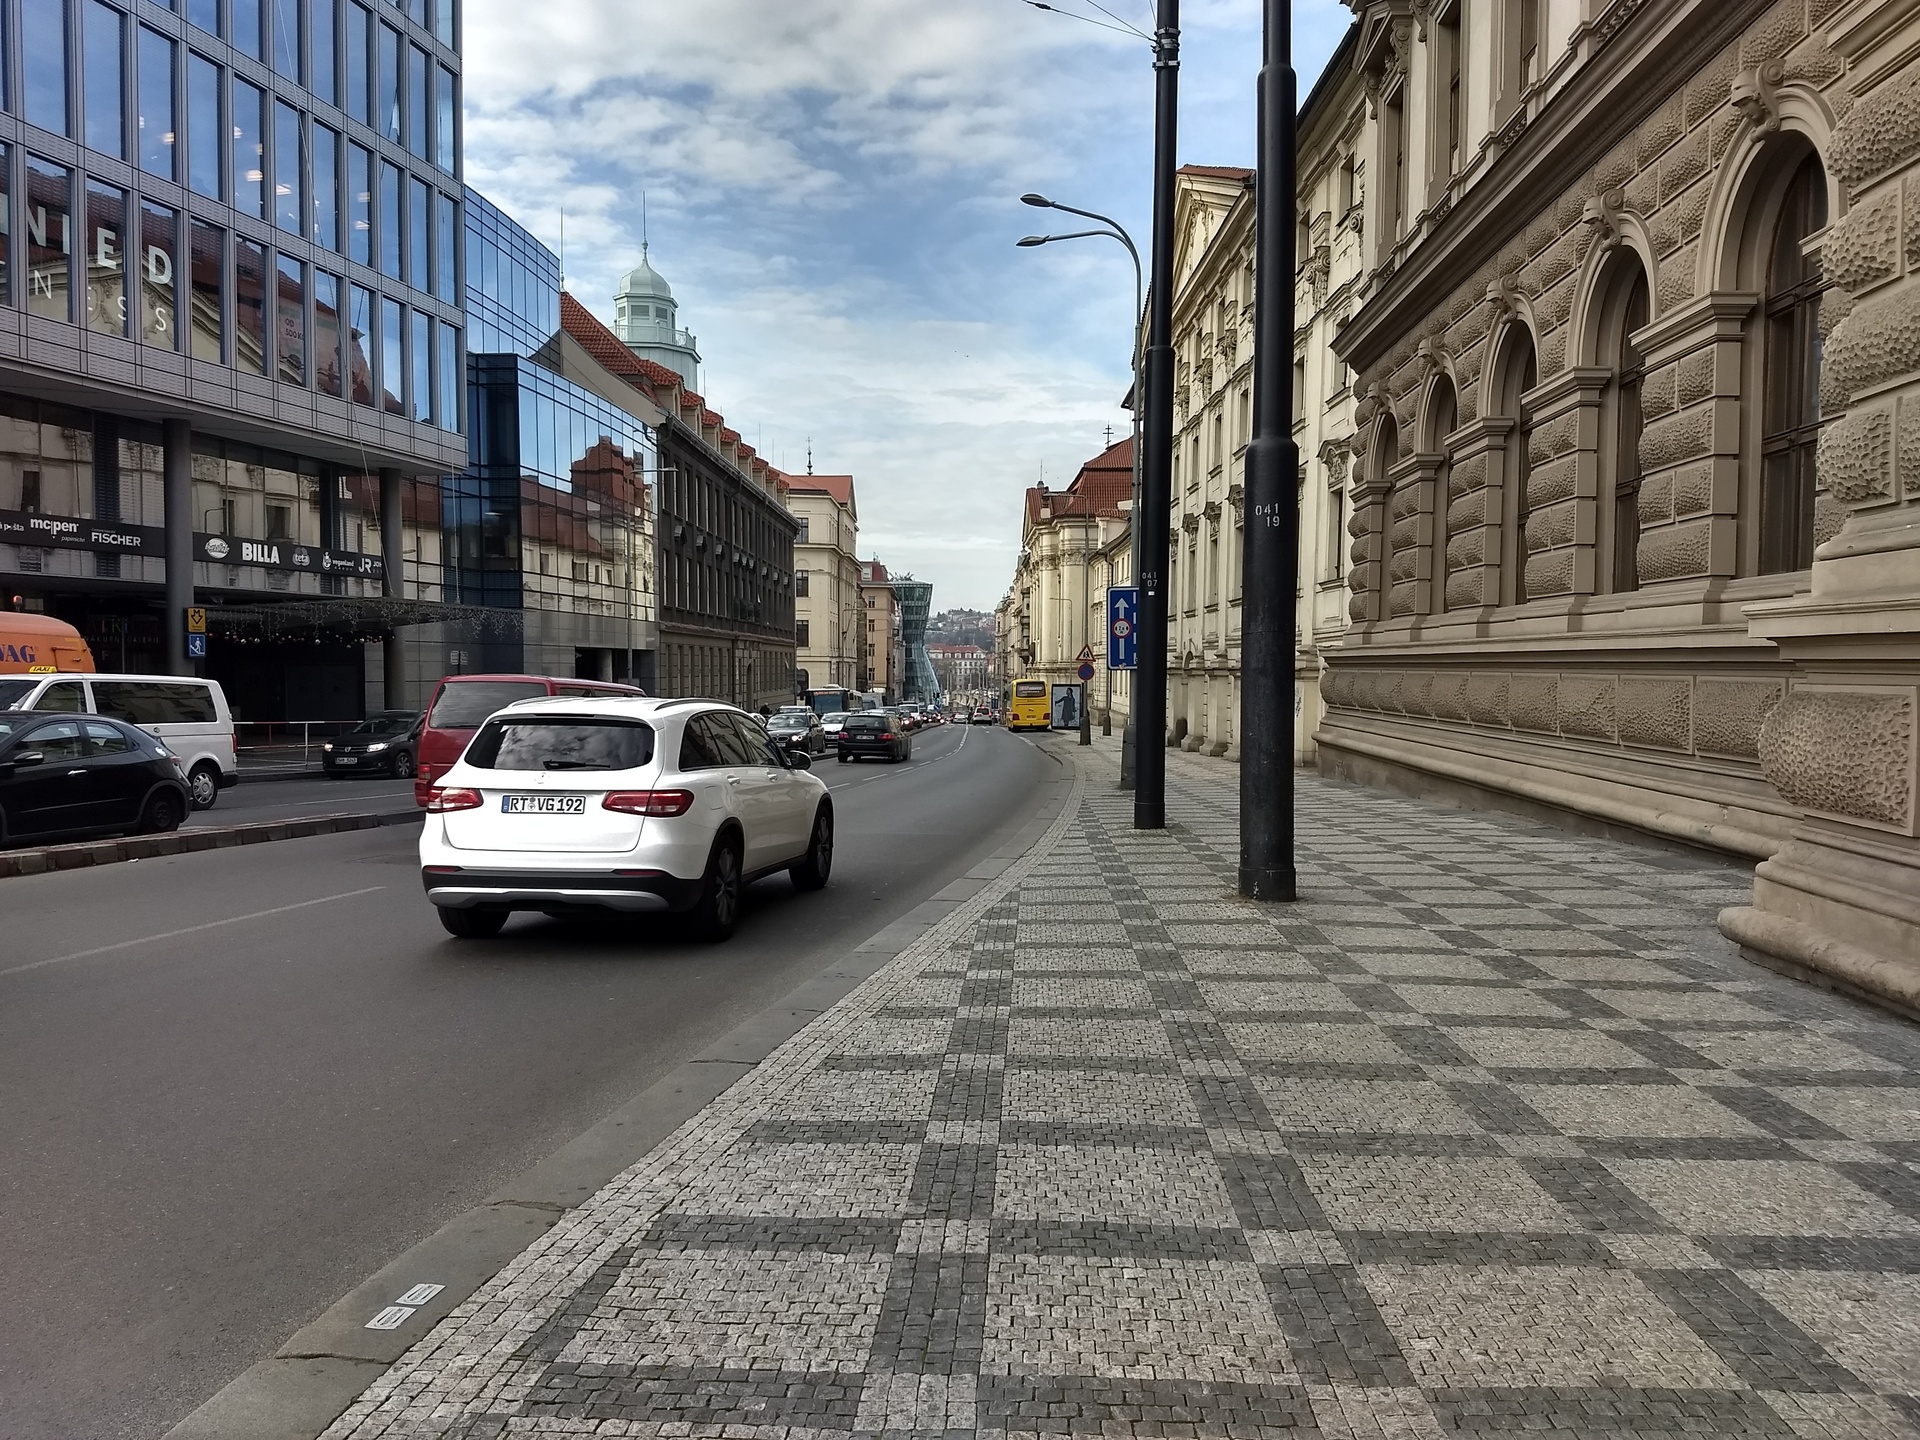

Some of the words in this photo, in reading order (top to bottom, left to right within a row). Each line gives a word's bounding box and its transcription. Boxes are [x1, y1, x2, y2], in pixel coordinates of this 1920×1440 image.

[1255, 503, 1279, 516] 041
[1266, 515, 1280, 527] 19
[91, 532, 141, 547] FISCHER
[242, 542, 280, 564] BILLA
[358, 558, 371, 573] JR
[1147, 579, 1158, 587] 07
